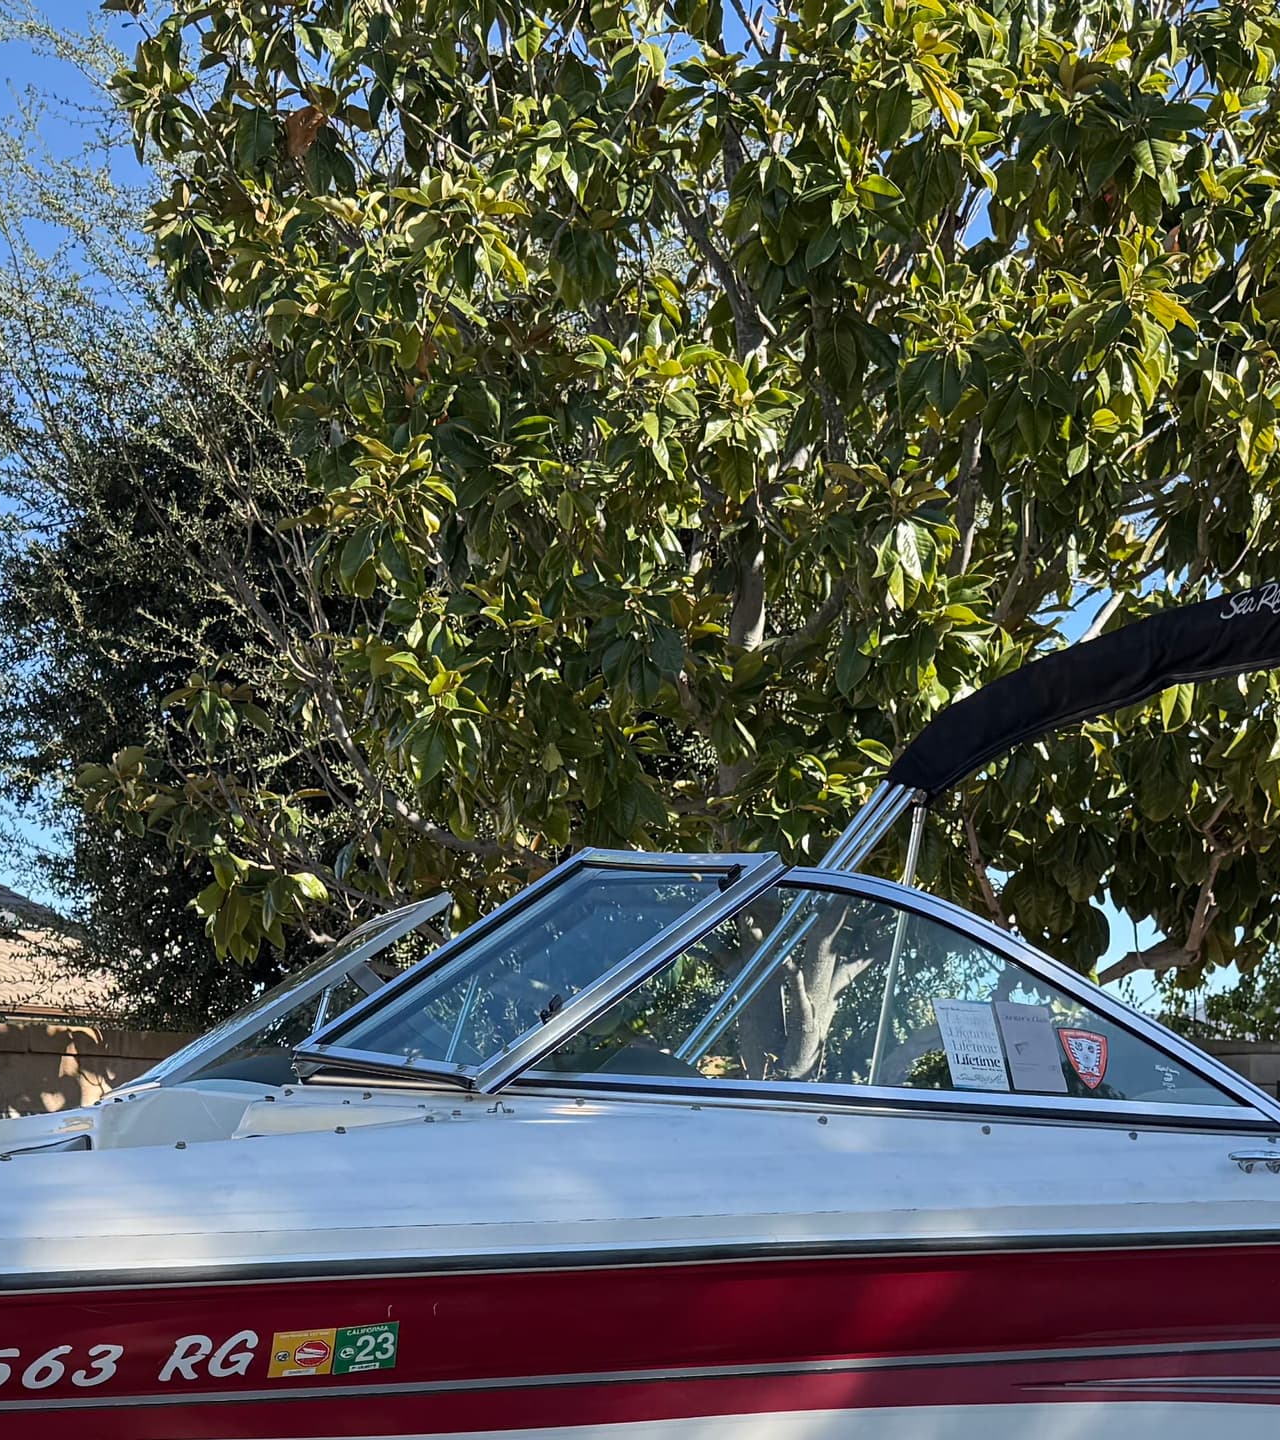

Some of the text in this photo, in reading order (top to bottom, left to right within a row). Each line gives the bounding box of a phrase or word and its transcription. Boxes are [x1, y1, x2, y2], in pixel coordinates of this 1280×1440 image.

[1219, 589, 1255, 620] Sea
[954, 1052, 1001, 1068] Lifetime
[346, 1325, 390, 1337] CALIFORNIA
[157, 1329, 260, 1383] RG
[354, 1331, 395, 1363] 23
